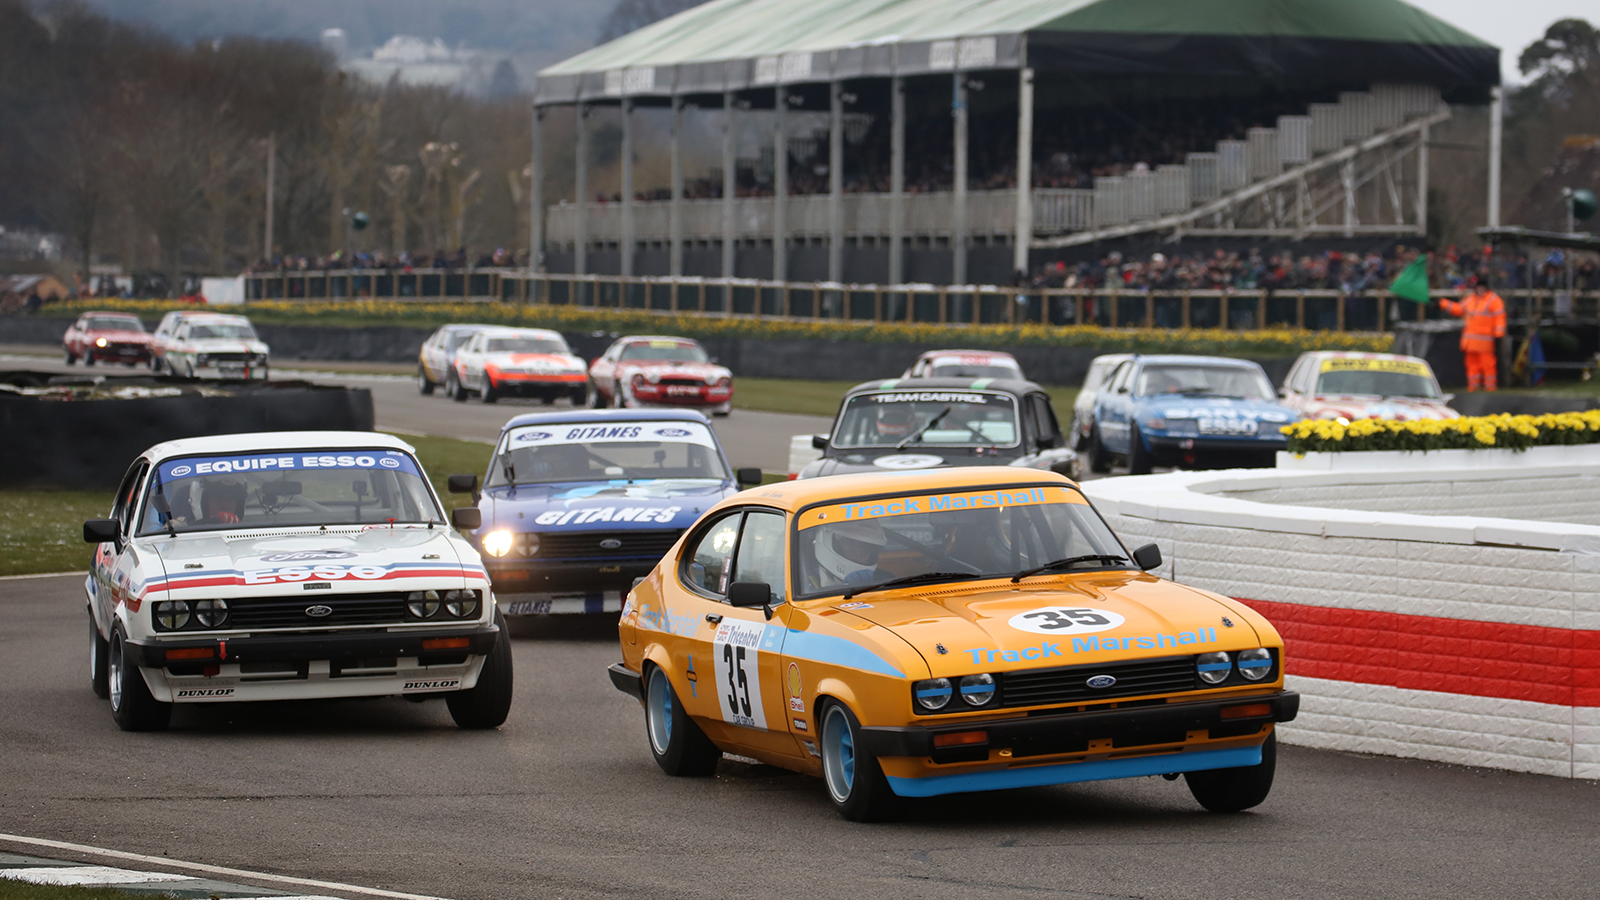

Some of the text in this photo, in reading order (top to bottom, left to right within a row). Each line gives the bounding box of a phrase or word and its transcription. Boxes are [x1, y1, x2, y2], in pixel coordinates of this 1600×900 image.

[875, 393, 988, 404] TEAM CASTROL
[1164, 407, 1289, 423] SANYO
[565, 426, 643, 440] GITANES
[1198, 418, 1259, 435] ESSO
[195, 455, 376, 474] EQUIPE ESSO
[840, 487, 1046, 520] Track Marshall
[534, 505, 682, 526] GITANES
[268, 551, 349, 562] Ford
[244, 564, 388, 585] ESSO
[508, 600, 553, 614] GITANES
[638, 603, 664, 632] Track
[659, 608, 703, 637] Marshall
[1023, 608, 1111, 631] 35
[727, 625, 762, 647] Tricentrol
[964, 626, 1218, 666] Track Marshall
[403, 680, 459, 689] DUNLOP
[724, 644, 752, 718] 35
[1093, 677, 1110, 686] Ford
[177, 688, 235, 697] DUNLOP
[790, 700, 805, 711] Shell
